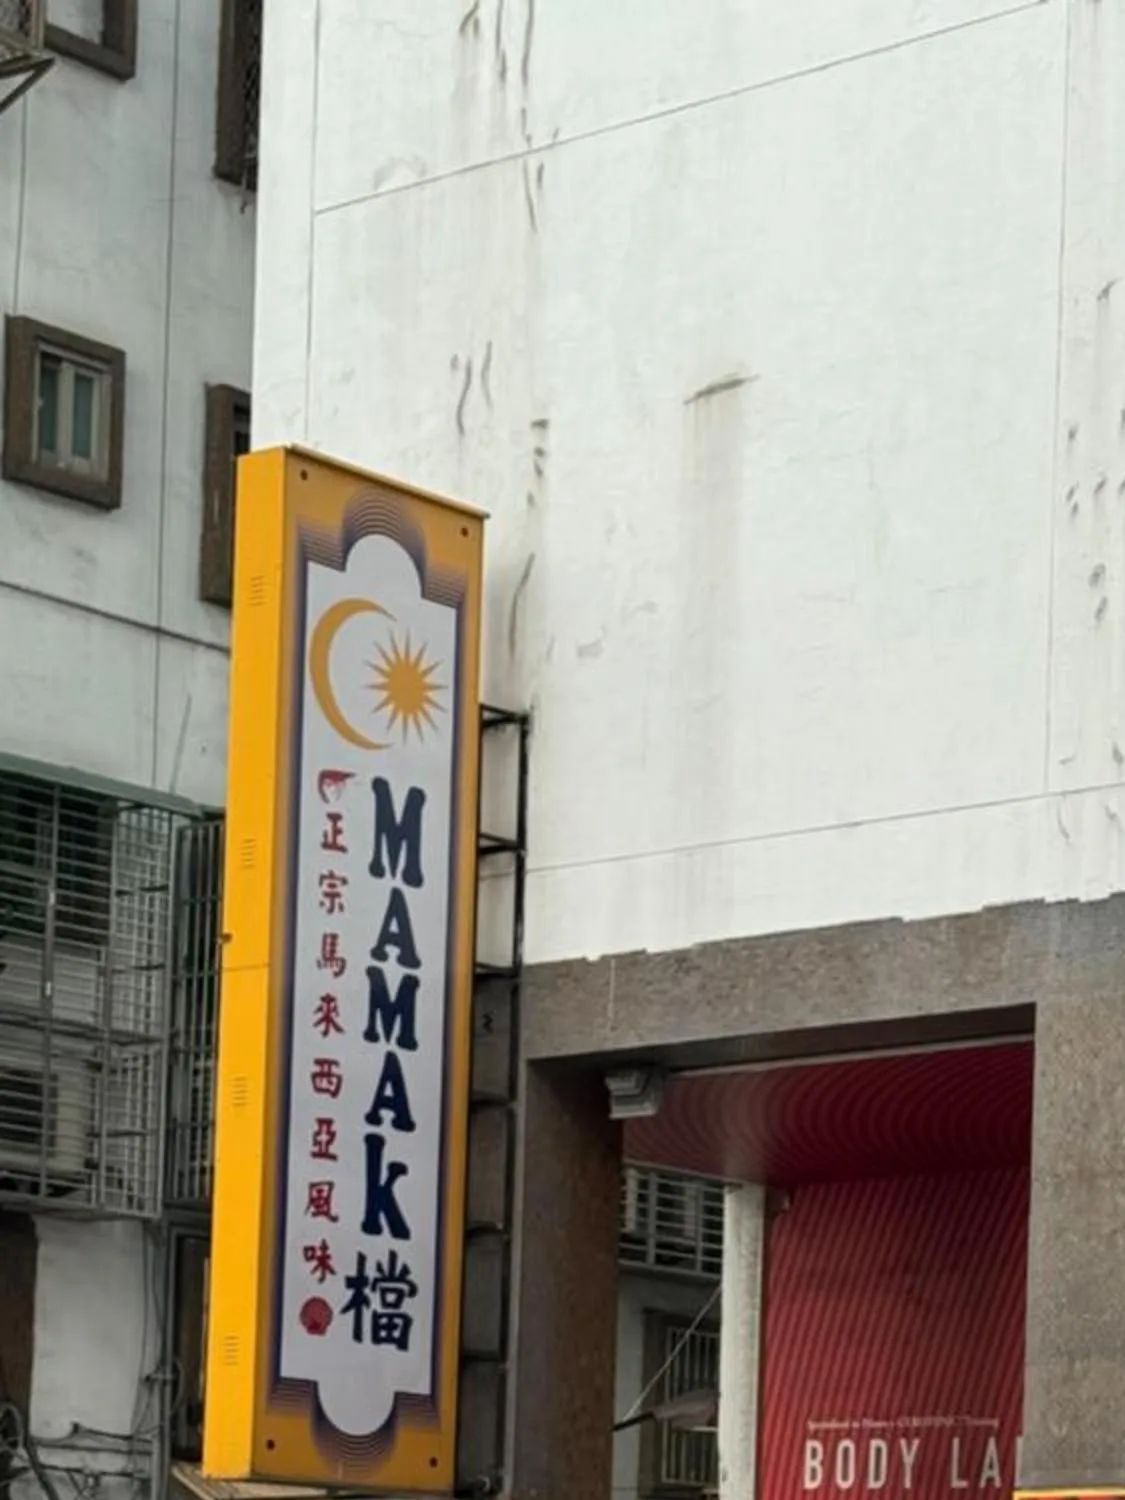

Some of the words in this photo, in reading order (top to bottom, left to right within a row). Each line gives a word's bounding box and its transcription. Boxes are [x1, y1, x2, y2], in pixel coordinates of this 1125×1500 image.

[302, 811, 349, 1283] 正宗馬來西亞風味
[804, 1438, 920, 1489] BODY
[950, 1435, 1024, 1488] LA
